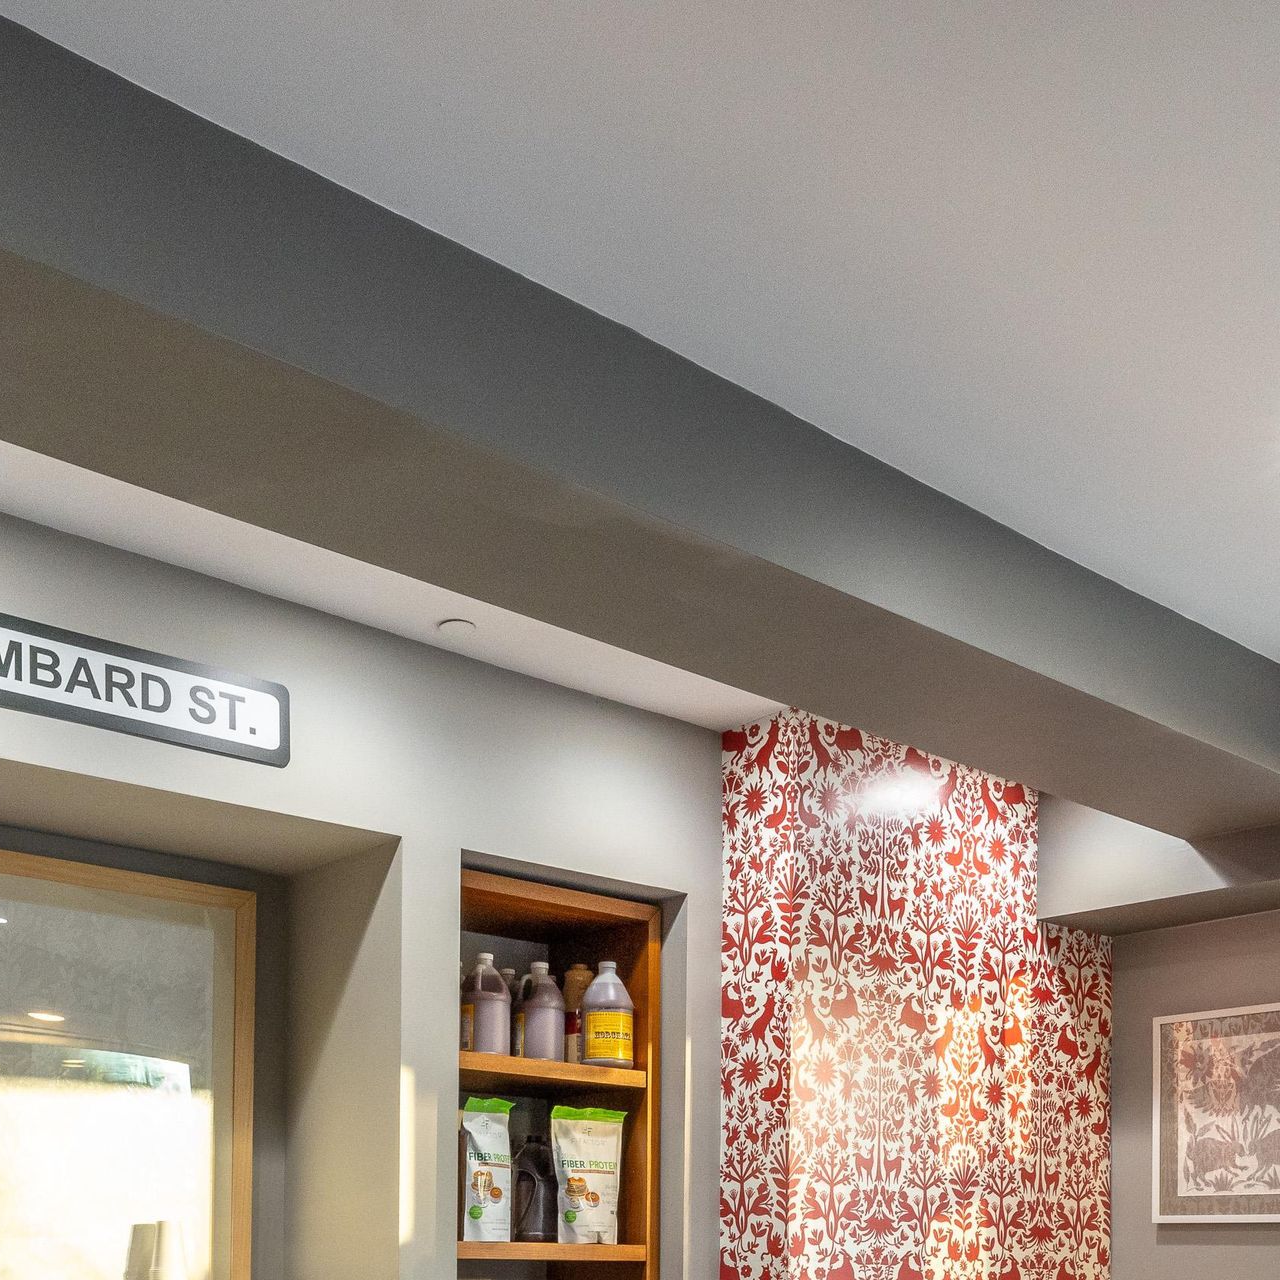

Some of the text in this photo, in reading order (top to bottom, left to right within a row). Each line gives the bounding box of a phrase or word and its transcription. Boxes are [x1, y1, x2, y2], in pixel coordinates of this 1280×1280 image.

[188, 685, 257, 736] ST.
[469, 1151, 492, 1162] FIBER
[561, 1159, 586, 1169] FIBER
